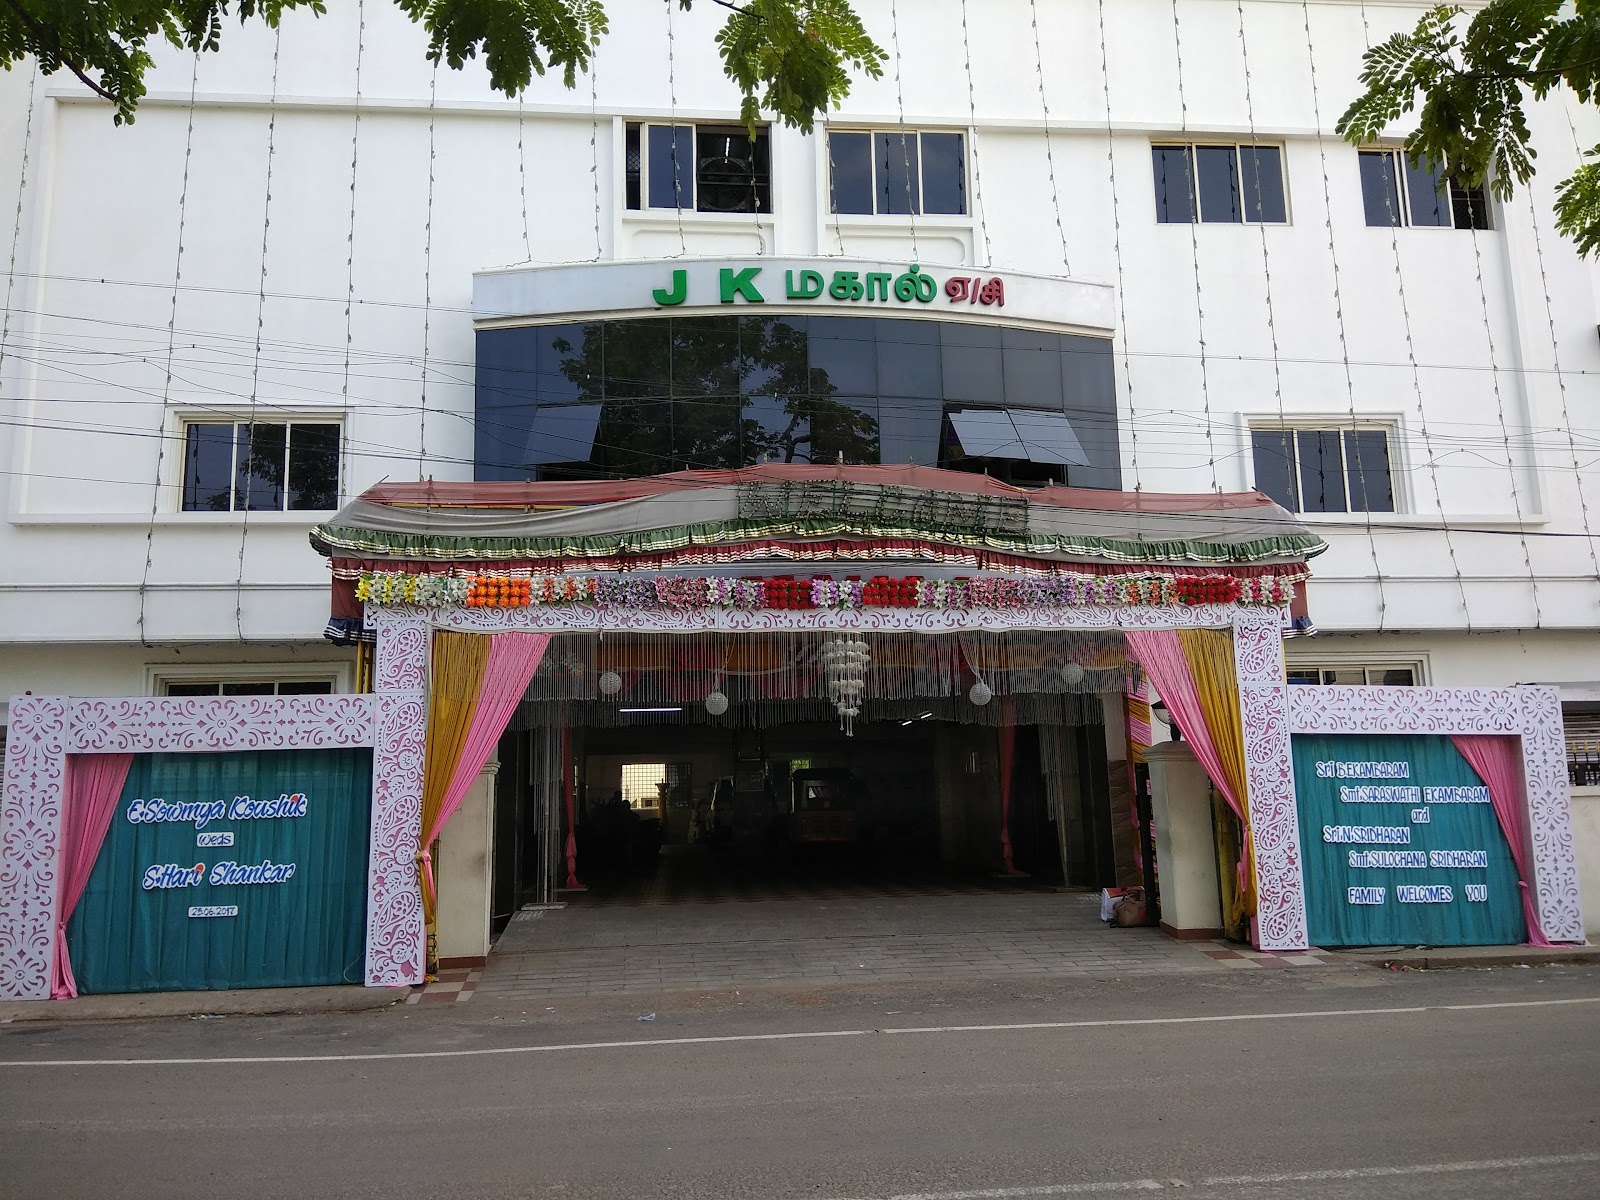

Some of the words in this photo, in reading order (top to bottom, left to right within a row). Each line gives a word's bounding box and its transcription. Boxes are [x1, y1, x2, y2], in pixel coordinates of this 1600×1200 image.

[652, 269, 687, 305] J
[719, 267, 765, 303] K
[785, 263, 938, 302] மகால்
[1316, 761, 1335, 777] Sri
[1423, 787, 1490, 802] EKAMBARAM
[228, 793, 307, 819] Koushik
[1411, 807, 1430, 823] and
[1430, 851, 1487, 867] SRIDHARAN
[209, 860, 295, 885] Shankar
[1349, 887, 1385, 904] FAMILY
[1397, 886, 1453, 902] WELCOMES
[1465, 885, 1487, 901] YOU
